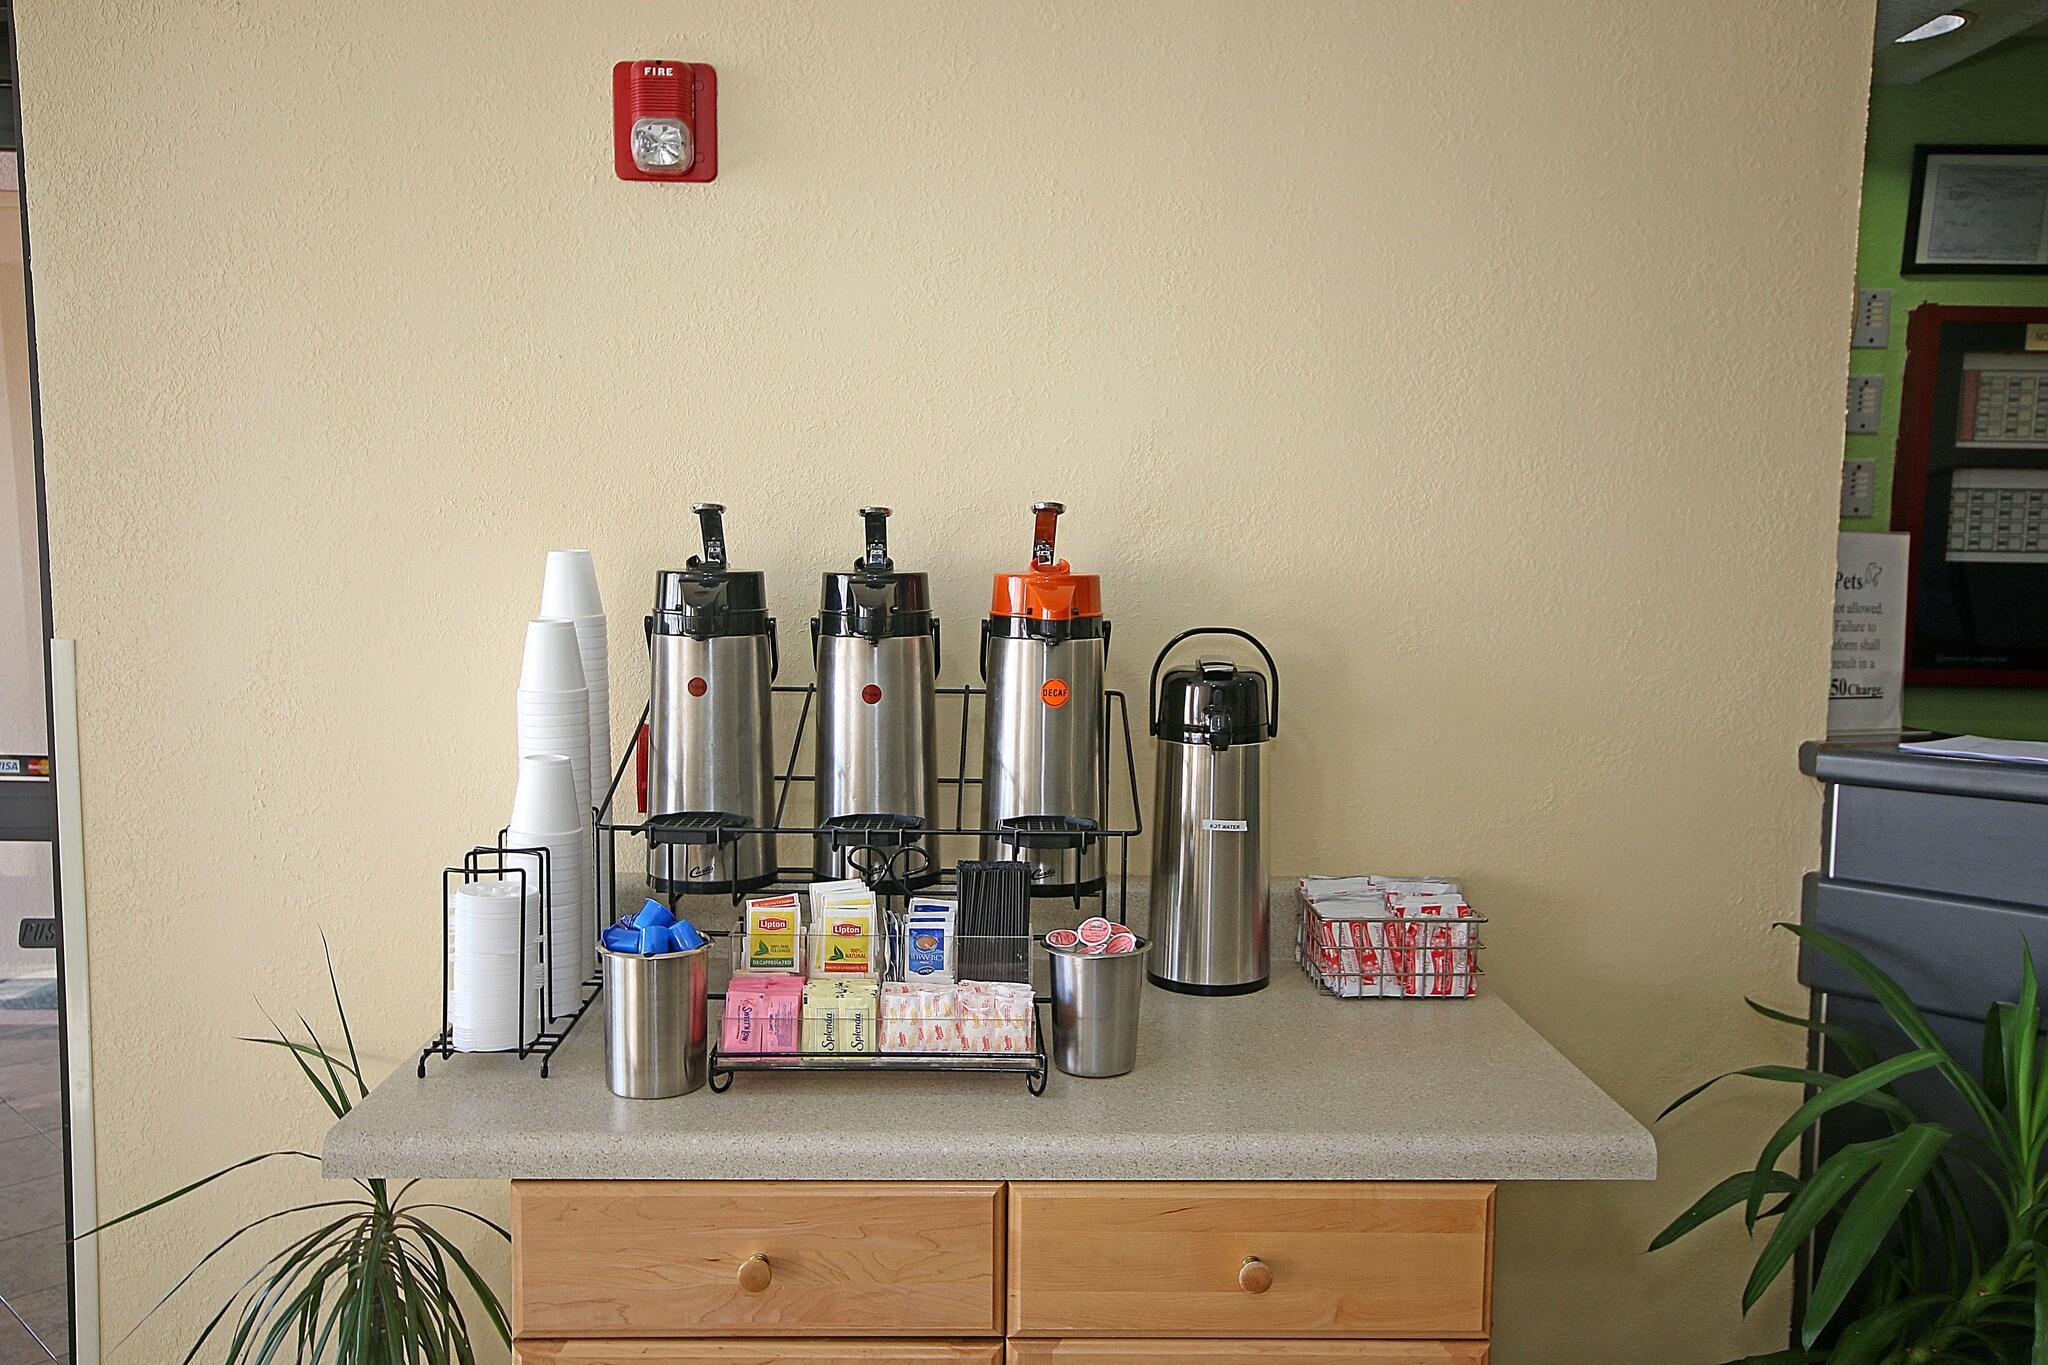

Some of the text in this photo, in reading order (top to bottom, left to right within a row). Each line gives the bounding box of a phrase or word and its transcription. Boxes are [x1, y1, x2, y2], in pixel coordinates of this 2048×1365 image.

[644, 66, 674, 77] FIRE
[1836, 571, 1864, 590] Pets
[1833, 603, 1845, 613] ot
[1835, 620, 1877, 632] Failure to
[1858, 657, 1868, 669] in
[1869, 660, 1876, 669] a
[1042, 688, 1068, 697] DECAF
[1829, 678, 1847, 697] 50
[0, 761, 18, 771] ISA
[760, 919, 786, 929] Lipton
[834, 925, 860, 935] Lipton
[22, 923, 56, 942] PUS
[821, 1012, 835, 1051] Splenda
[851, 1012, 864, 1051] Splenda
